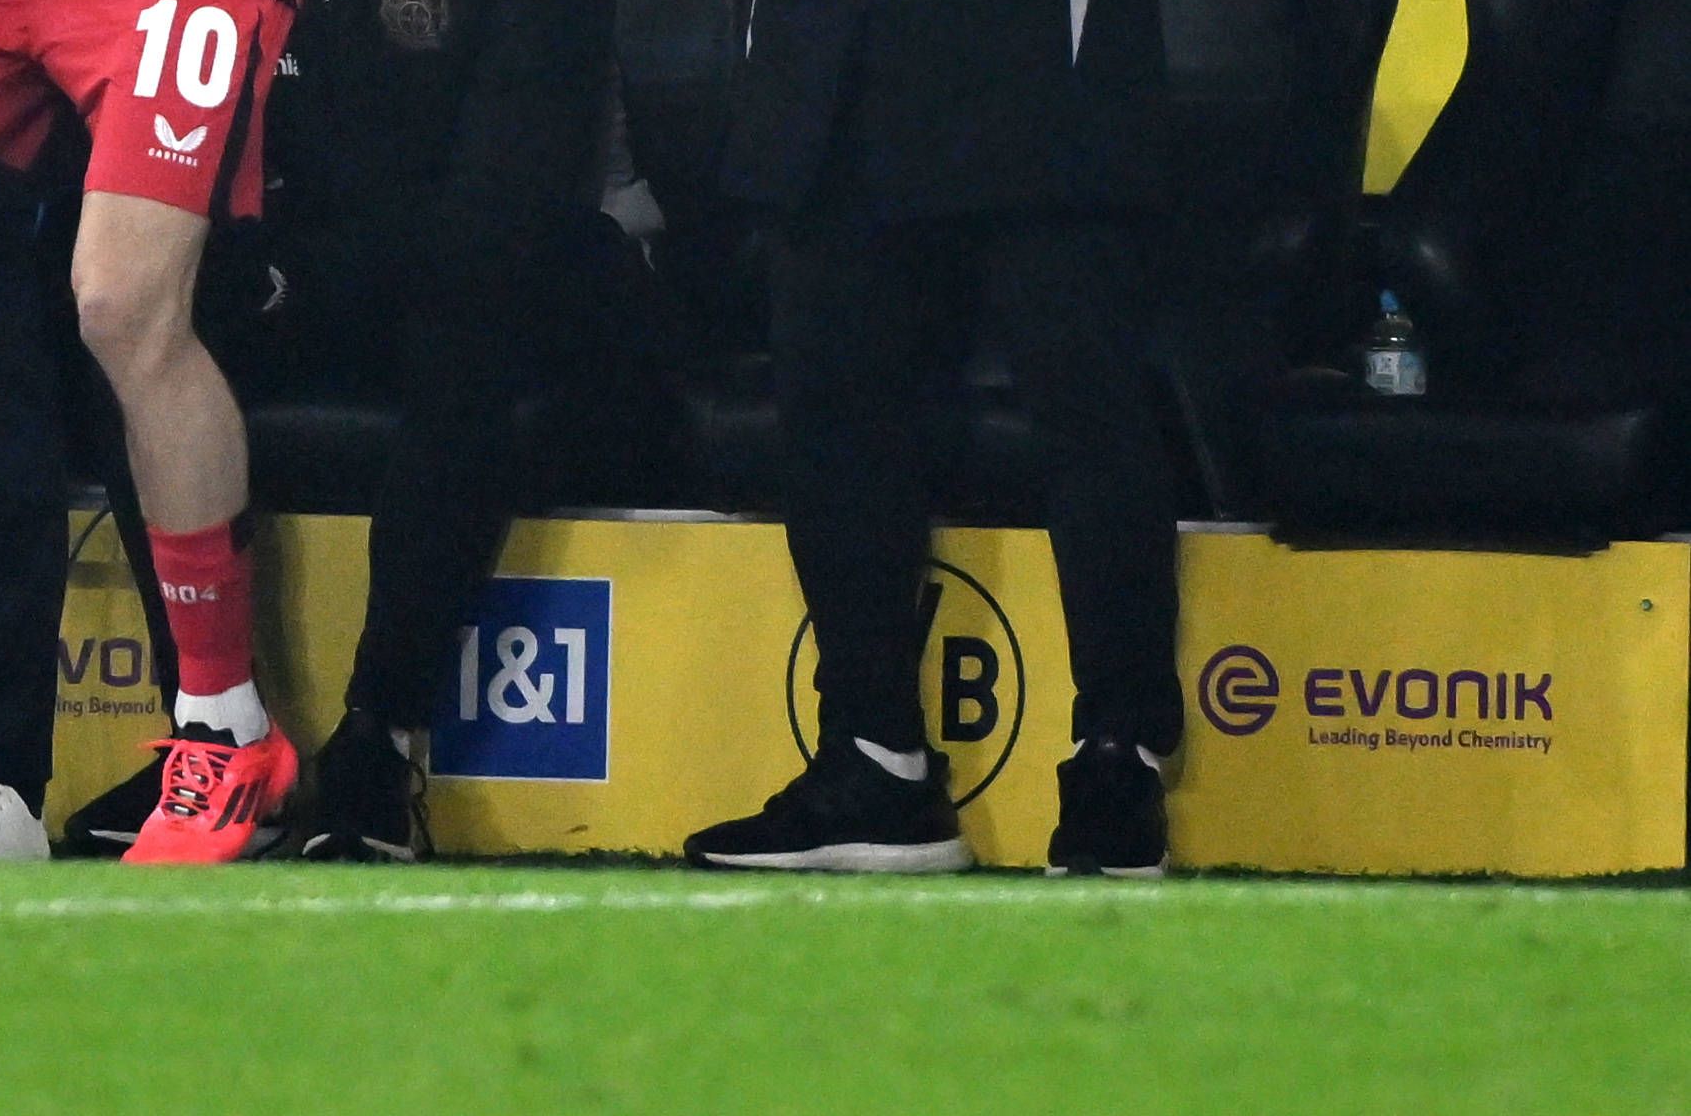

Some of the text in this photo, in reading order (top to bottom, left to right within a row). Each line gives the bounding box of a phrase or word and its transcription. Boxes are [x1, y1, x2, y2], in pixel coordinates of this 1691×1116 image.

[457, 625, 586, 723] 1&1
[89, 695, 155, 719] Beyond
[1304, 668, 1552, 720] EVONIK
[1309, 727, 1552, 754] Leading Beyond Chemistry
